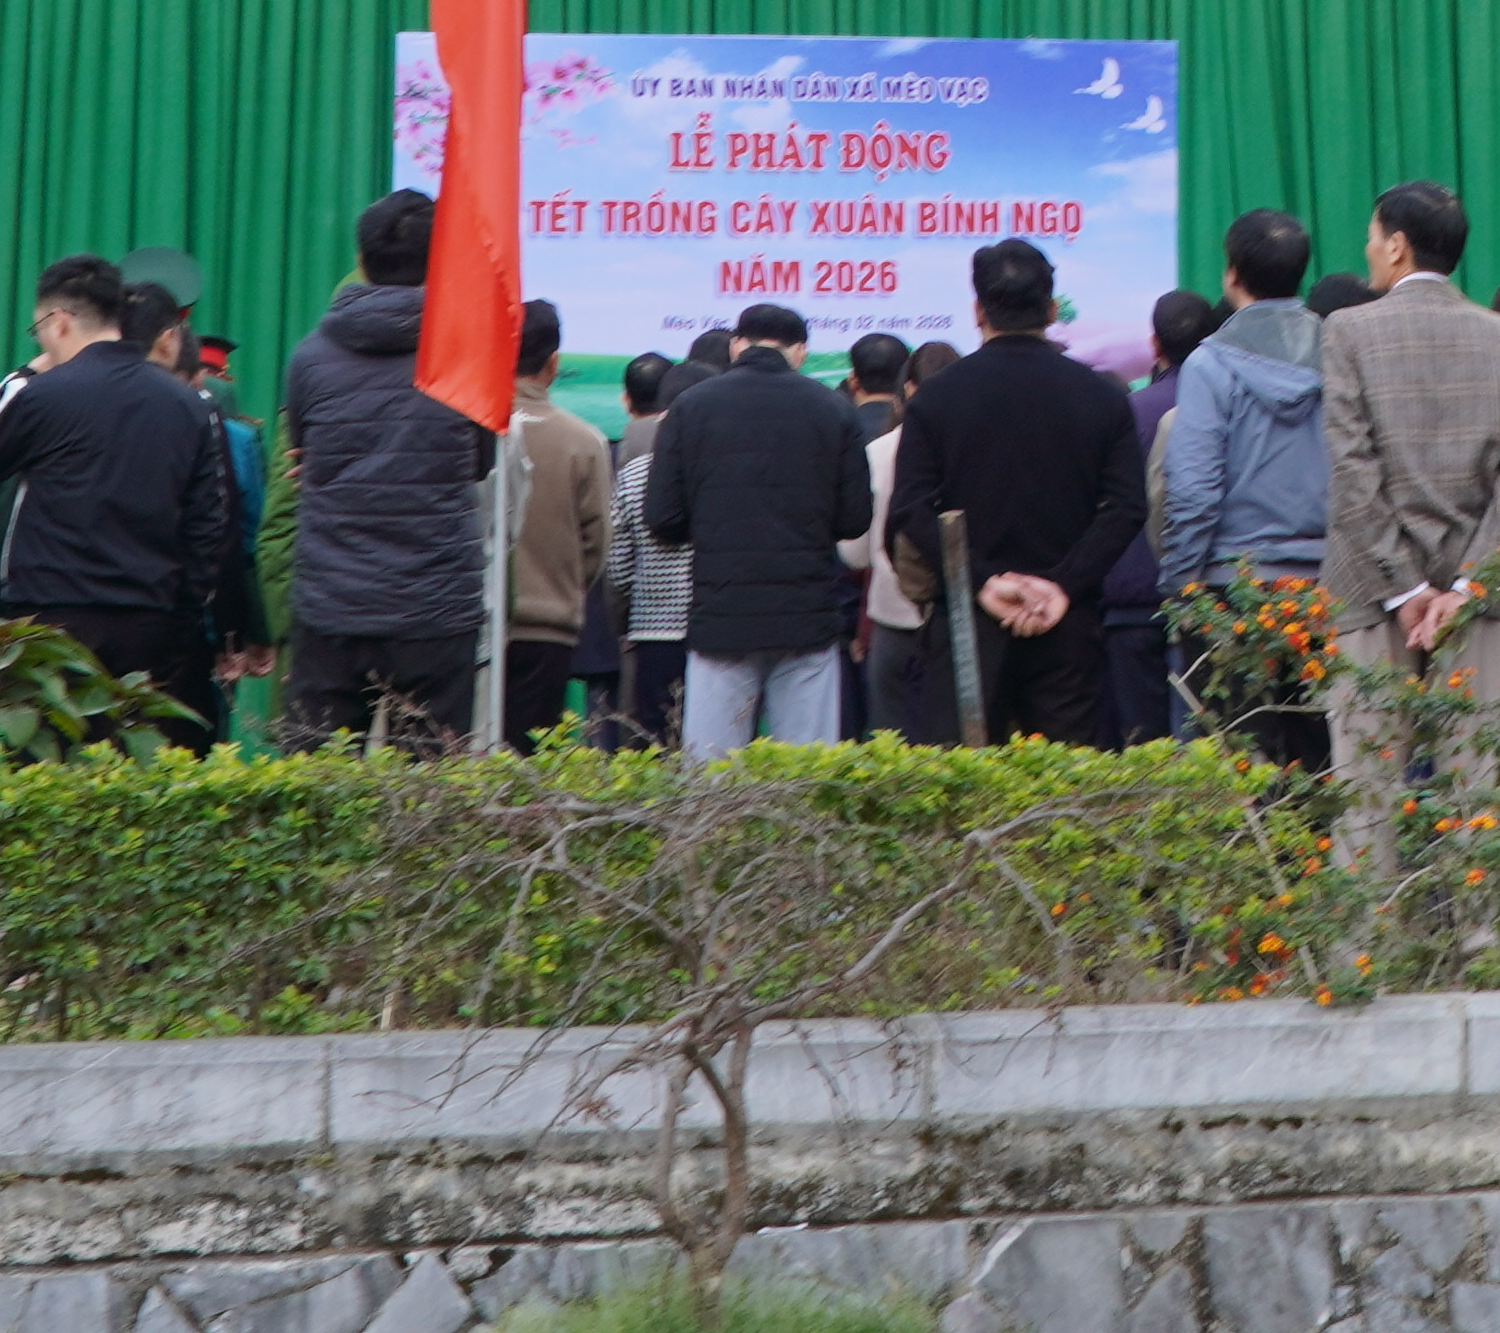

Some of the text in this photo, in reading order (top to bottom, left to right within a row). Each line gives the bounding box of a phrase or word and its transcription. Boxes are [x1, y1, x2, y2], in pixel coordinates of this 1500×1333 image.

[670, 75, 716, 99] BAN
[723, 71, 790, 101] NHÂN
[792, 71, 843, 101] DÂN
[845, 72, 878, 102] XÃ
[939, 76, 990, 107] VẠC
[669, 111, 952, 182] LỄ PHÁT ĐỘNG
[529, 189, 1083, 244] TẾT TRỒNG CÂY XUÂN BÍNH NGỌ
[719, 253, 898, 294] NĂM 2026
